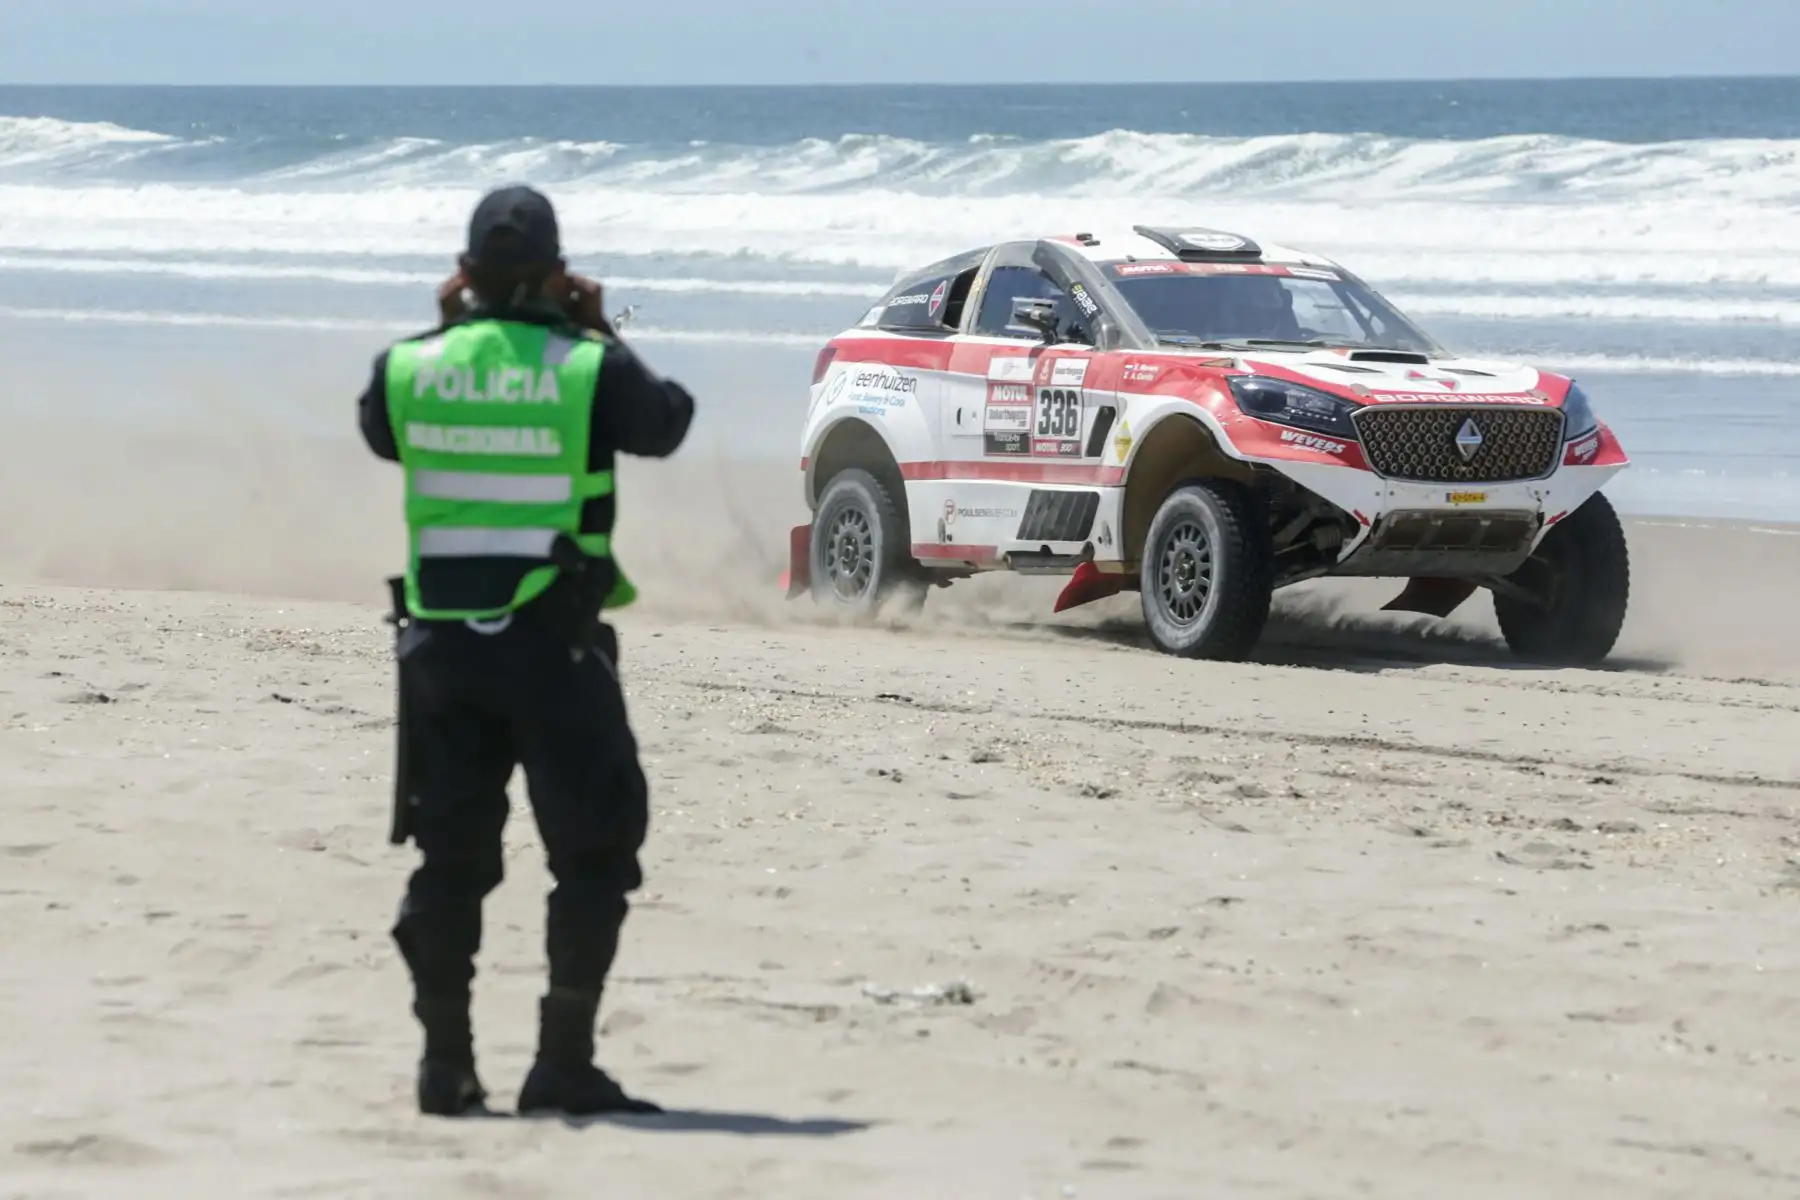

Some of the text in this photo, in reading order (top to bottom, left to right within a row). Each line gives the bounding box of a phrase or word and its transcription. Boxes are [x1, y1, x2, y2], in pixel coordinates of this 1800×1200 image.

[414, 364, 560, 404] POLICIA
[991, 384, 1029, 401] MOTUL
[1373, 393, 1545, 405] BORGWARD
[1038, 389, 1078, 437] 336
[406, 422, 561, 456] NACIONAL
[1035, 443, 1058, 453] MOTUL
[1280, 430, 1346, 454] WEVERS
